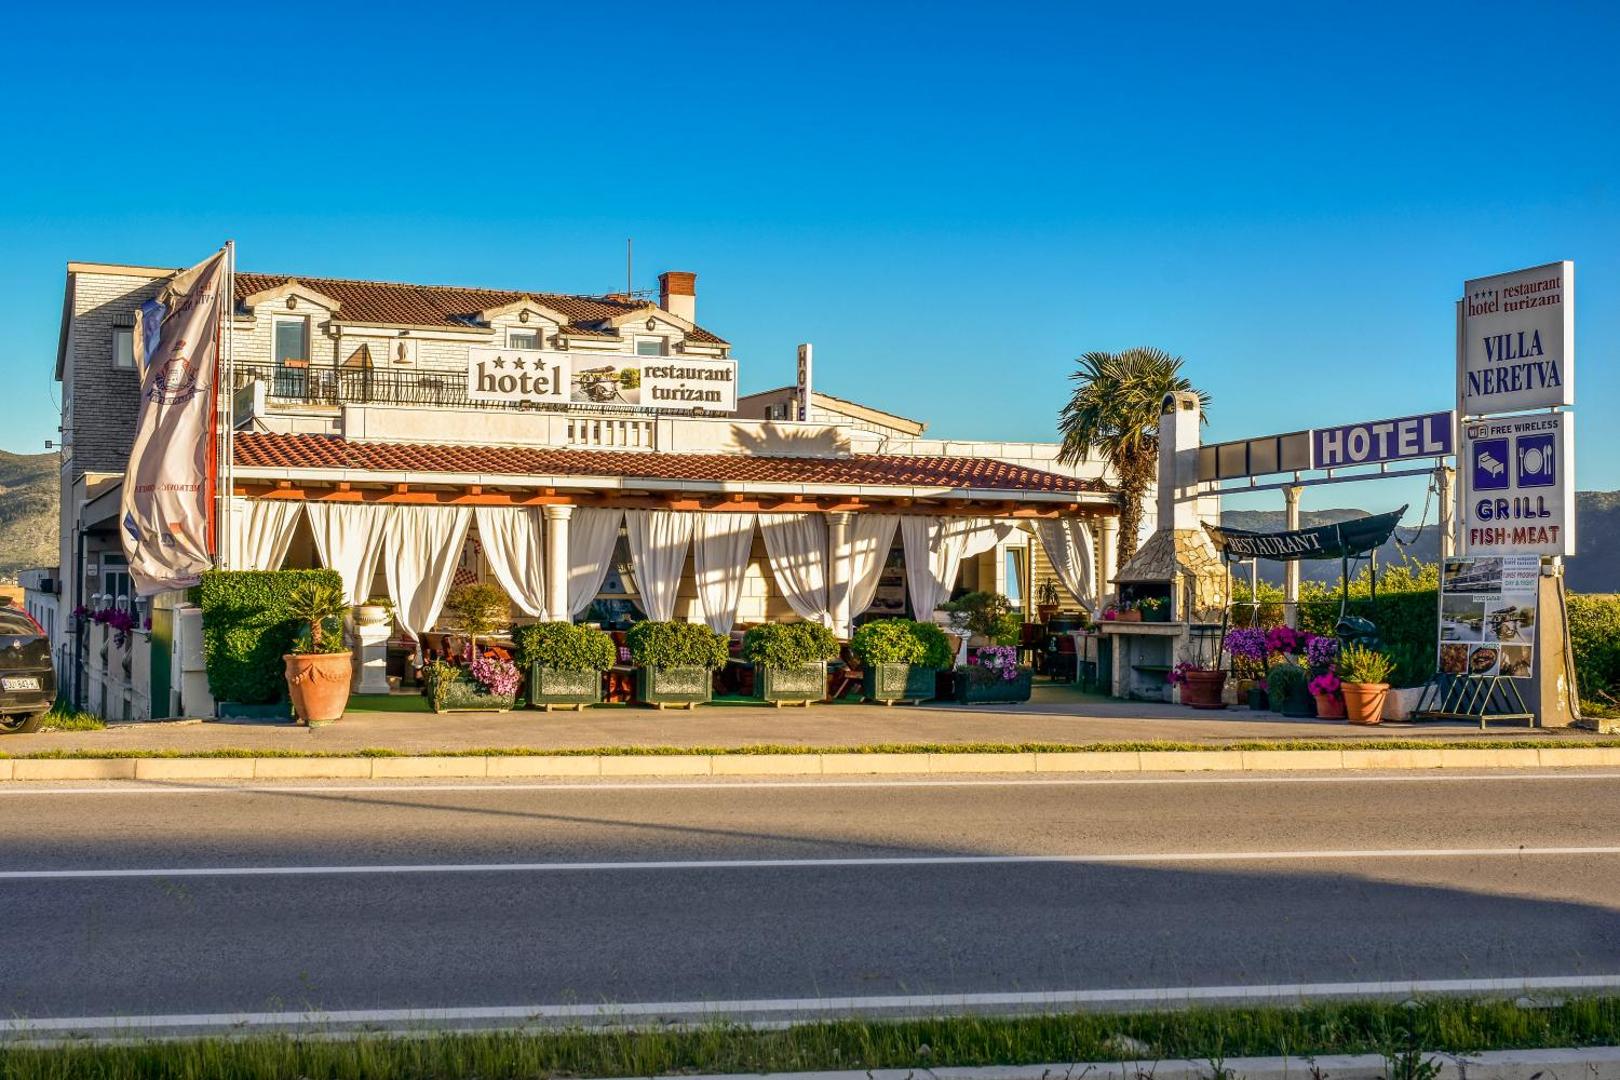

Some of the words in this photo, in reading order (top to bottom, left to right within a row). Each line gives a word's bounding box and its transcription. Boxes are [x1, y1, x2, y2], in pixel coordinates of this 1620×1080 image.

[1503, 277, 1560, 298] restaurant
[1468, 291, 1499, 316] hotel
[1504, 294, 1560, 312] turizam
[1483, 329, 1544, 362] VILLA
[476, 361, 562, 395] hotel
[644, 364, 732, 381] restaurant
[1467, 360, 1561, 397] NERETVA
[651, 383, 722, 402] turizam
[1490, 425, 1512, 435] FREE
[1515, 420, 1559, 432] WIRELESS
[1322, 417, 1444, 465] HOTEL
[1475, 496, 1551, 522] GRILL
[1227, 532, 1320, 555] RESTAURANT
